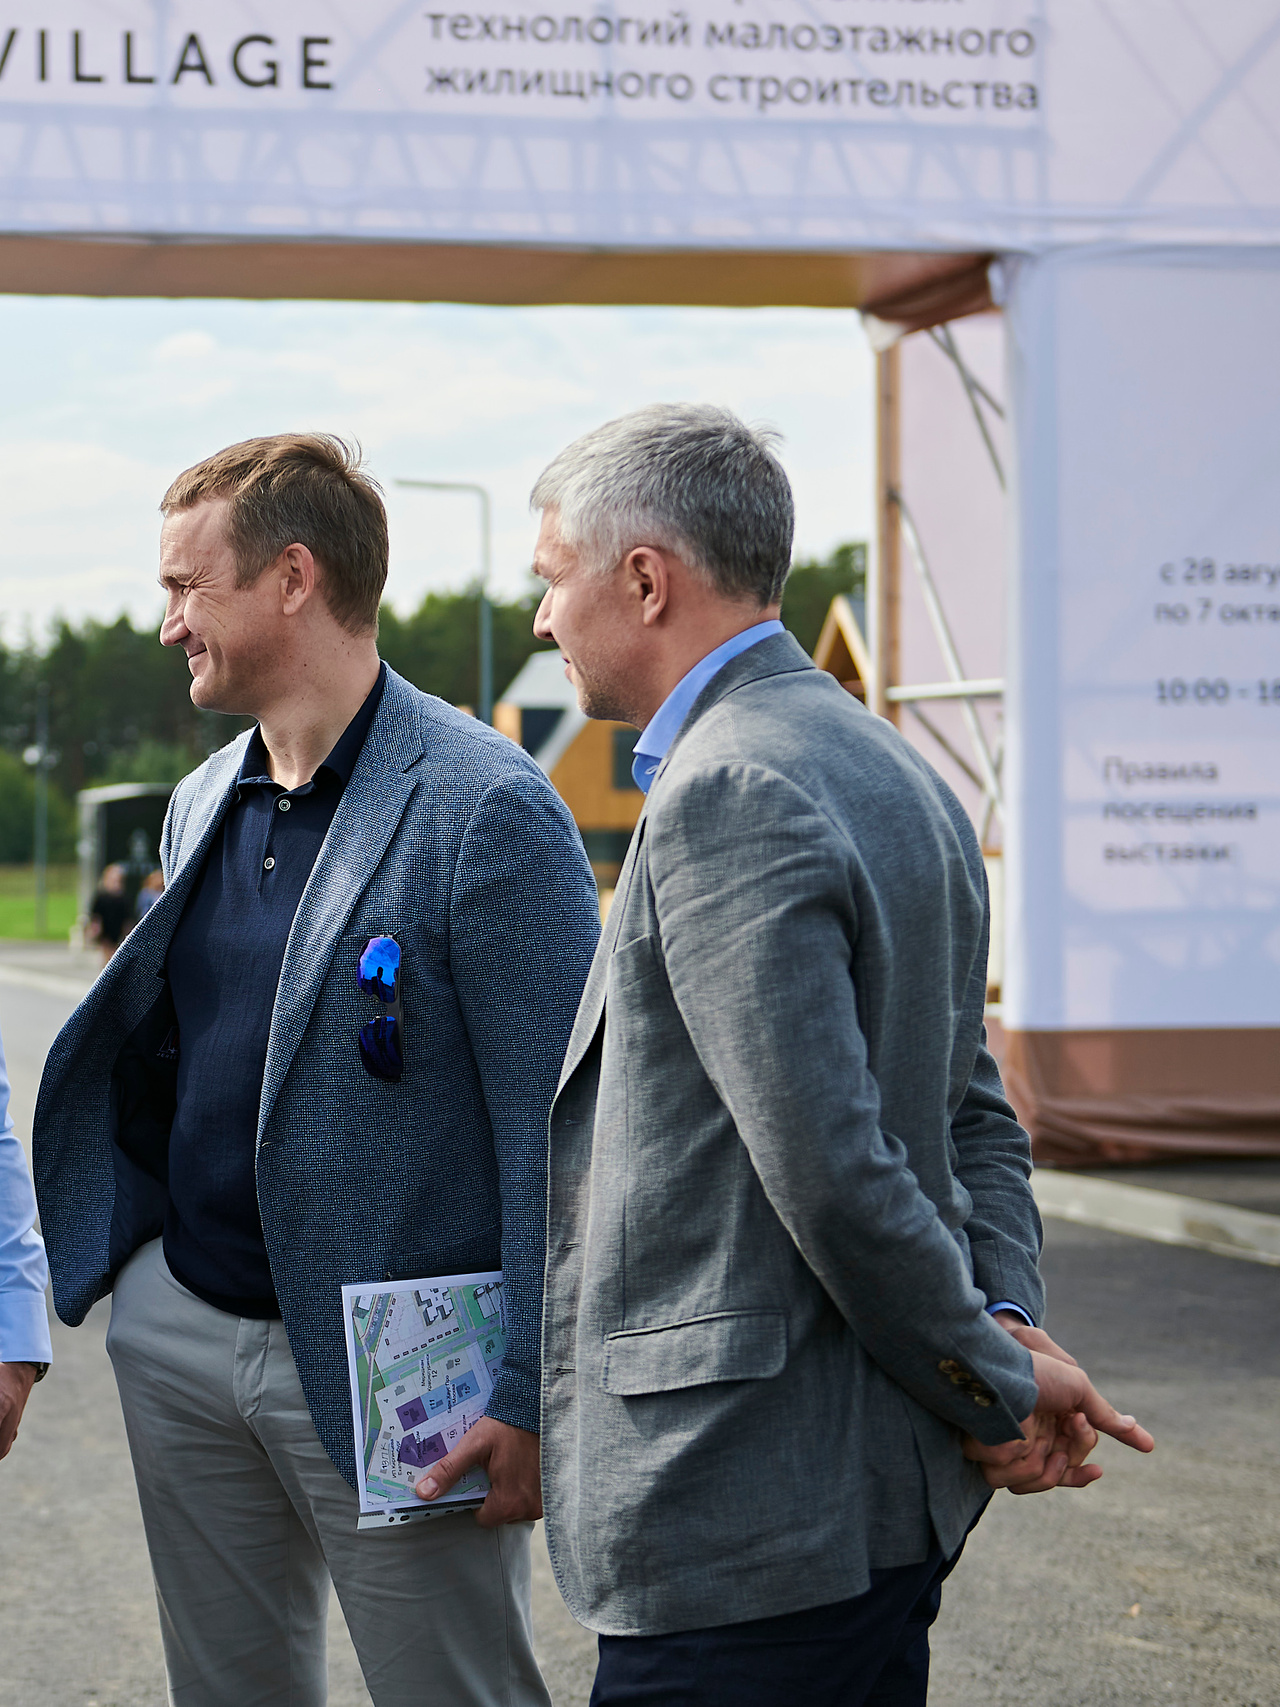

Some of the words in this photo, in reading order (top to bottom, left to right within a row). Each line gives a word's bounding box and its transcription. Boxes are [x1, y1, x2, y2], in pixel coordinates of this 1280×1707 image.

[425, 10, 690, 45] технологий
[704, 19, 1036, 57] малоэтажного
[425, 67, 695, 102] жилищного
[707, 73, 1040, 112] строительства
[1159, 562, 1175, 586] с
[1183, 557, 1216, 586] 28
[1154, 602, 1191, 626] по
[1197, 597, 1213, 624] 7
[1104, 756, 1220, 787] Правила
[1103, 803, 1258, 827] посещения
[485, 1344, 492, 1354] 20
[432, 1370, 438, 1379] 12
